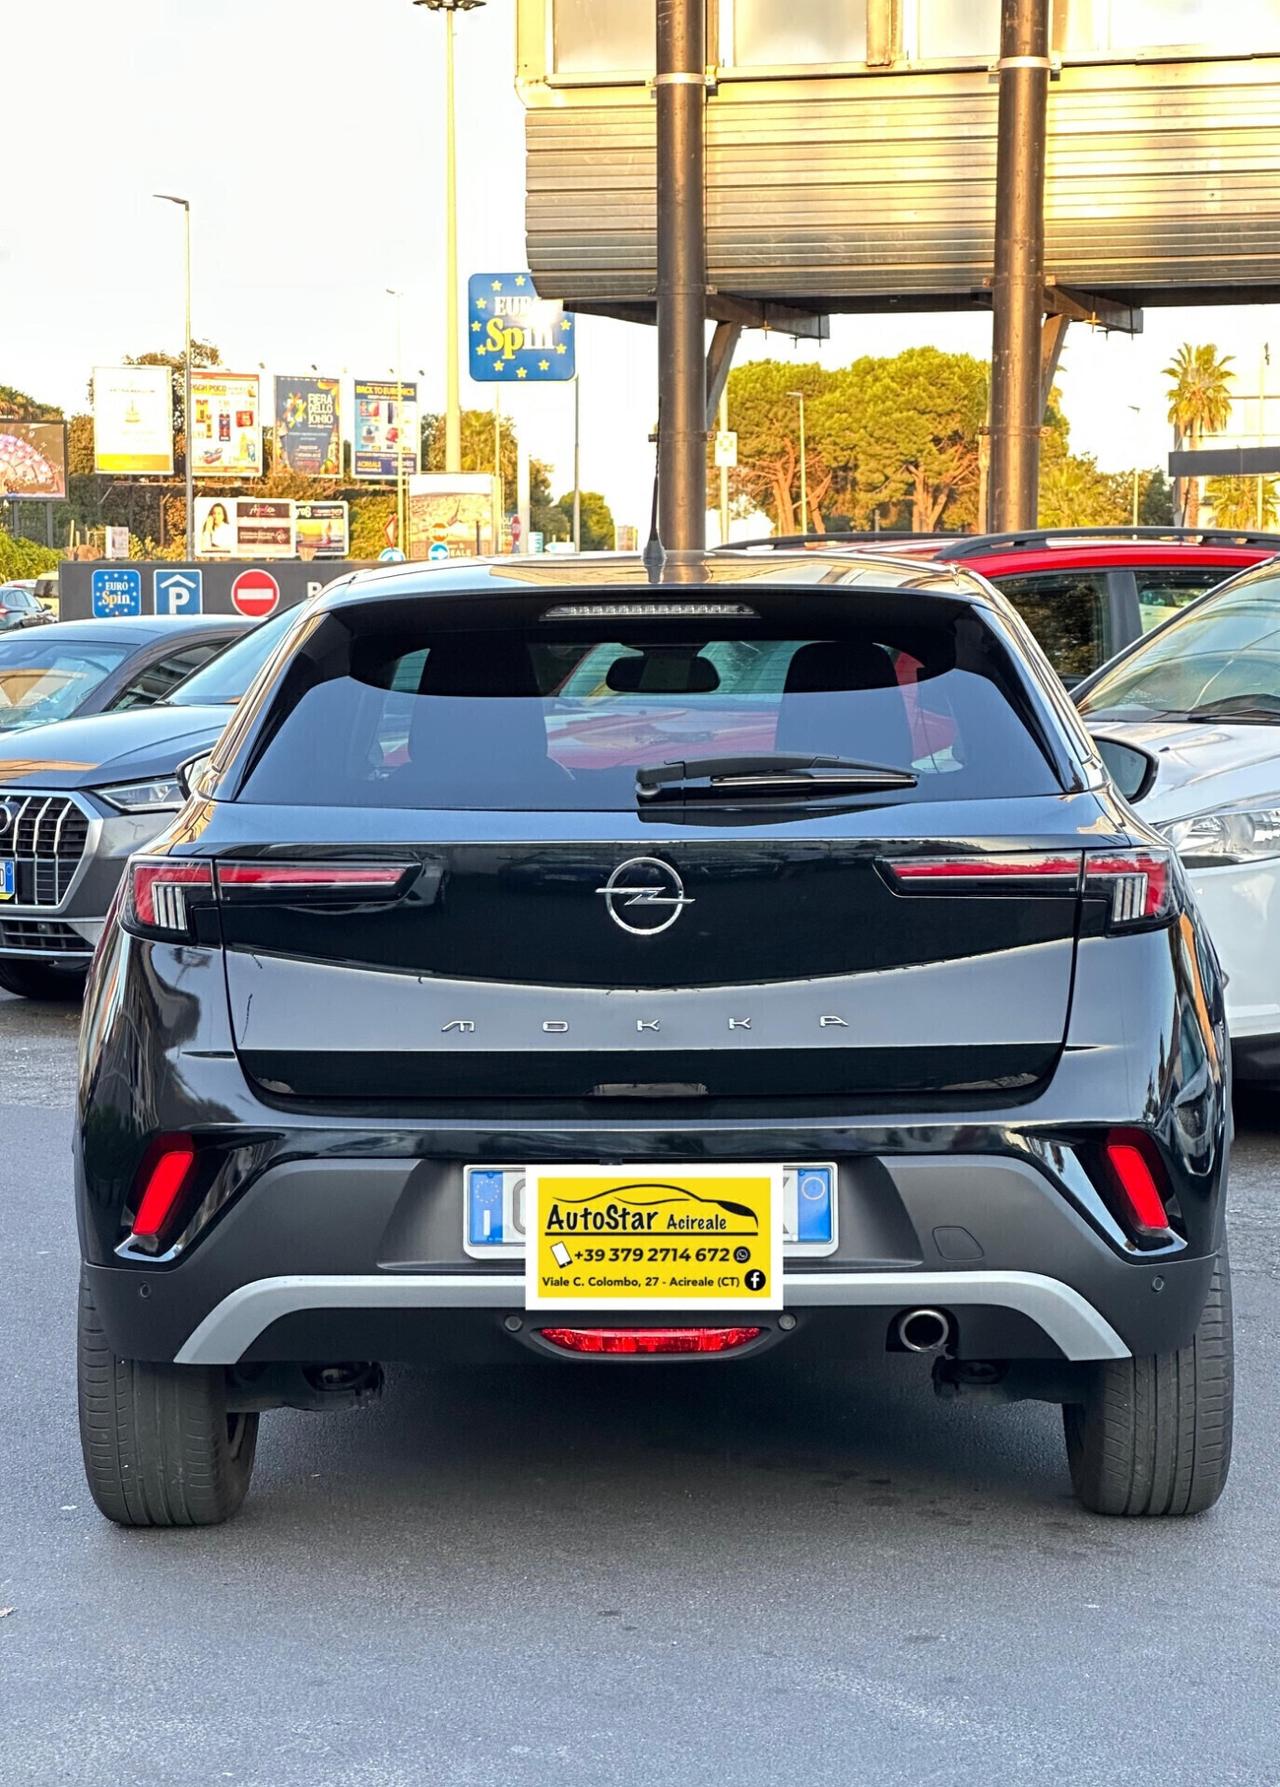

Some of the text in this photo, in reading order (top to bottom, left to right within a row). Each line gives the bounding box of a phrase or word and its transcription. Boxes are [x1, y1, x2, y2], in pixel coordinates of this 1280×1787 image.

[486, 317, 556, 360] Spin
[308, 393, 333, 403] FIERA
[308, 403, 333, 414] DELLO
[105, 581, 129, 591] EURO
[102, 590, 130, 608] Spin
[168, 587, 190, 615] P
